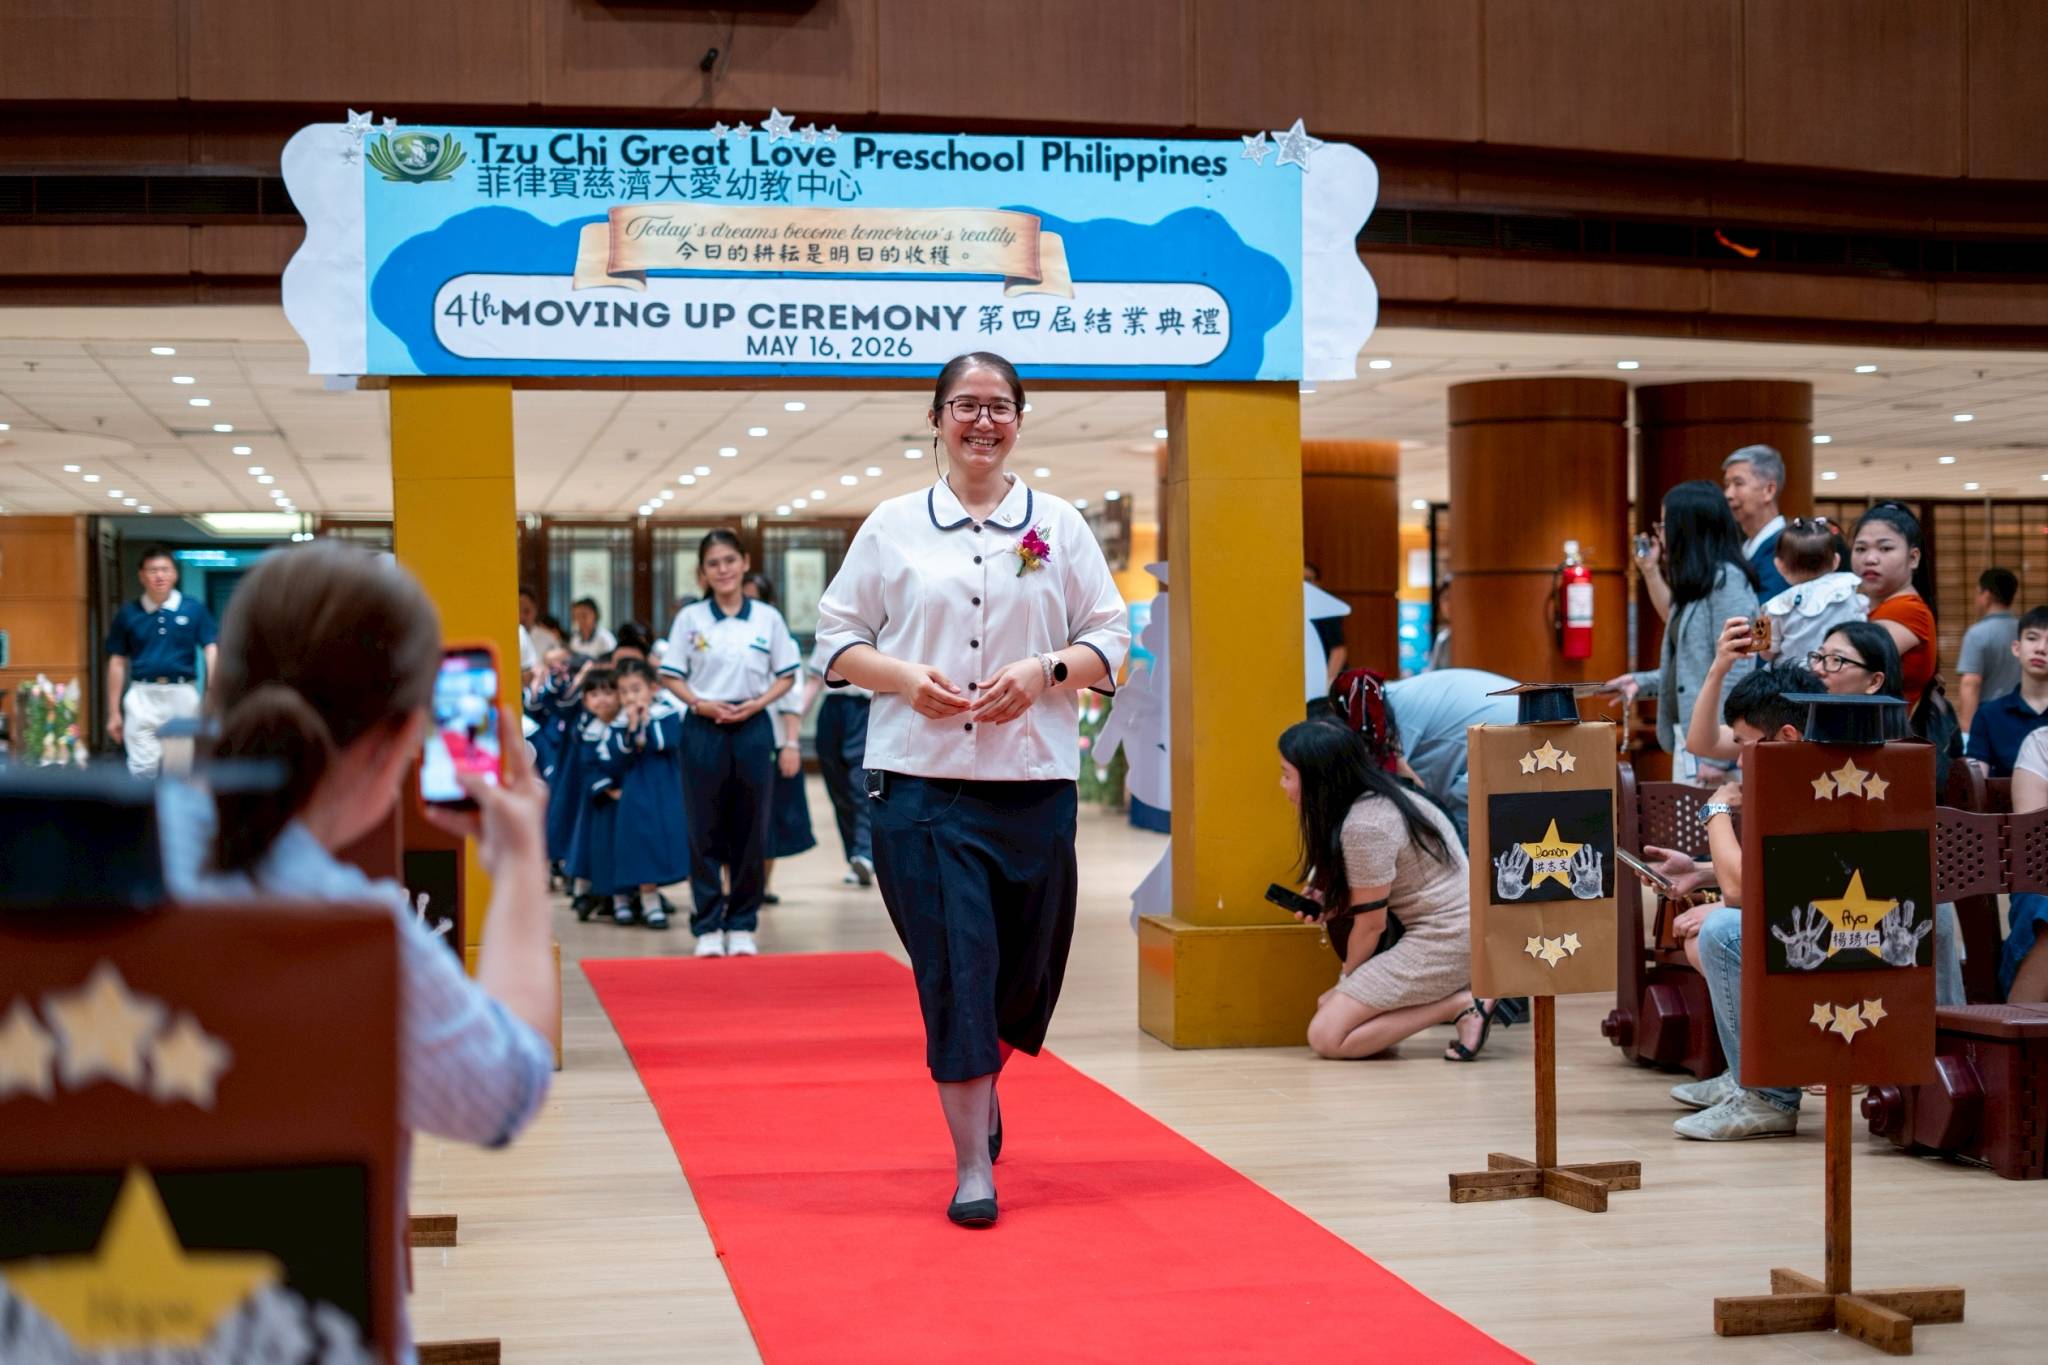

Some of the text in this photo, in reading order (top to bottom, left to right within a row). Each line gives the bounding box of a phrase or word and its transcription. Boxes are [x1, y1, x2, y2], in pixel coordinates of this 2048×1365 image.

[474, 132, 1228, 182] Tzu Chi Great Love Preschool Philippines
[477, 164, 862, 203] 菲律賓慈濟大愛幼教中心
[625, 215, 705, 241] Today's
[711, 222, 778, 239] dreams
[783, 222, 847, 241] become
[850, 224, 953, 242] tomorrow's
[444, 290, 968, 331] 4th MOVING UP CEREMONY
[977, 305, 1222, 336] 第四屆結業典禮
[747, 335, 913, 359] MAY 16, 2026
